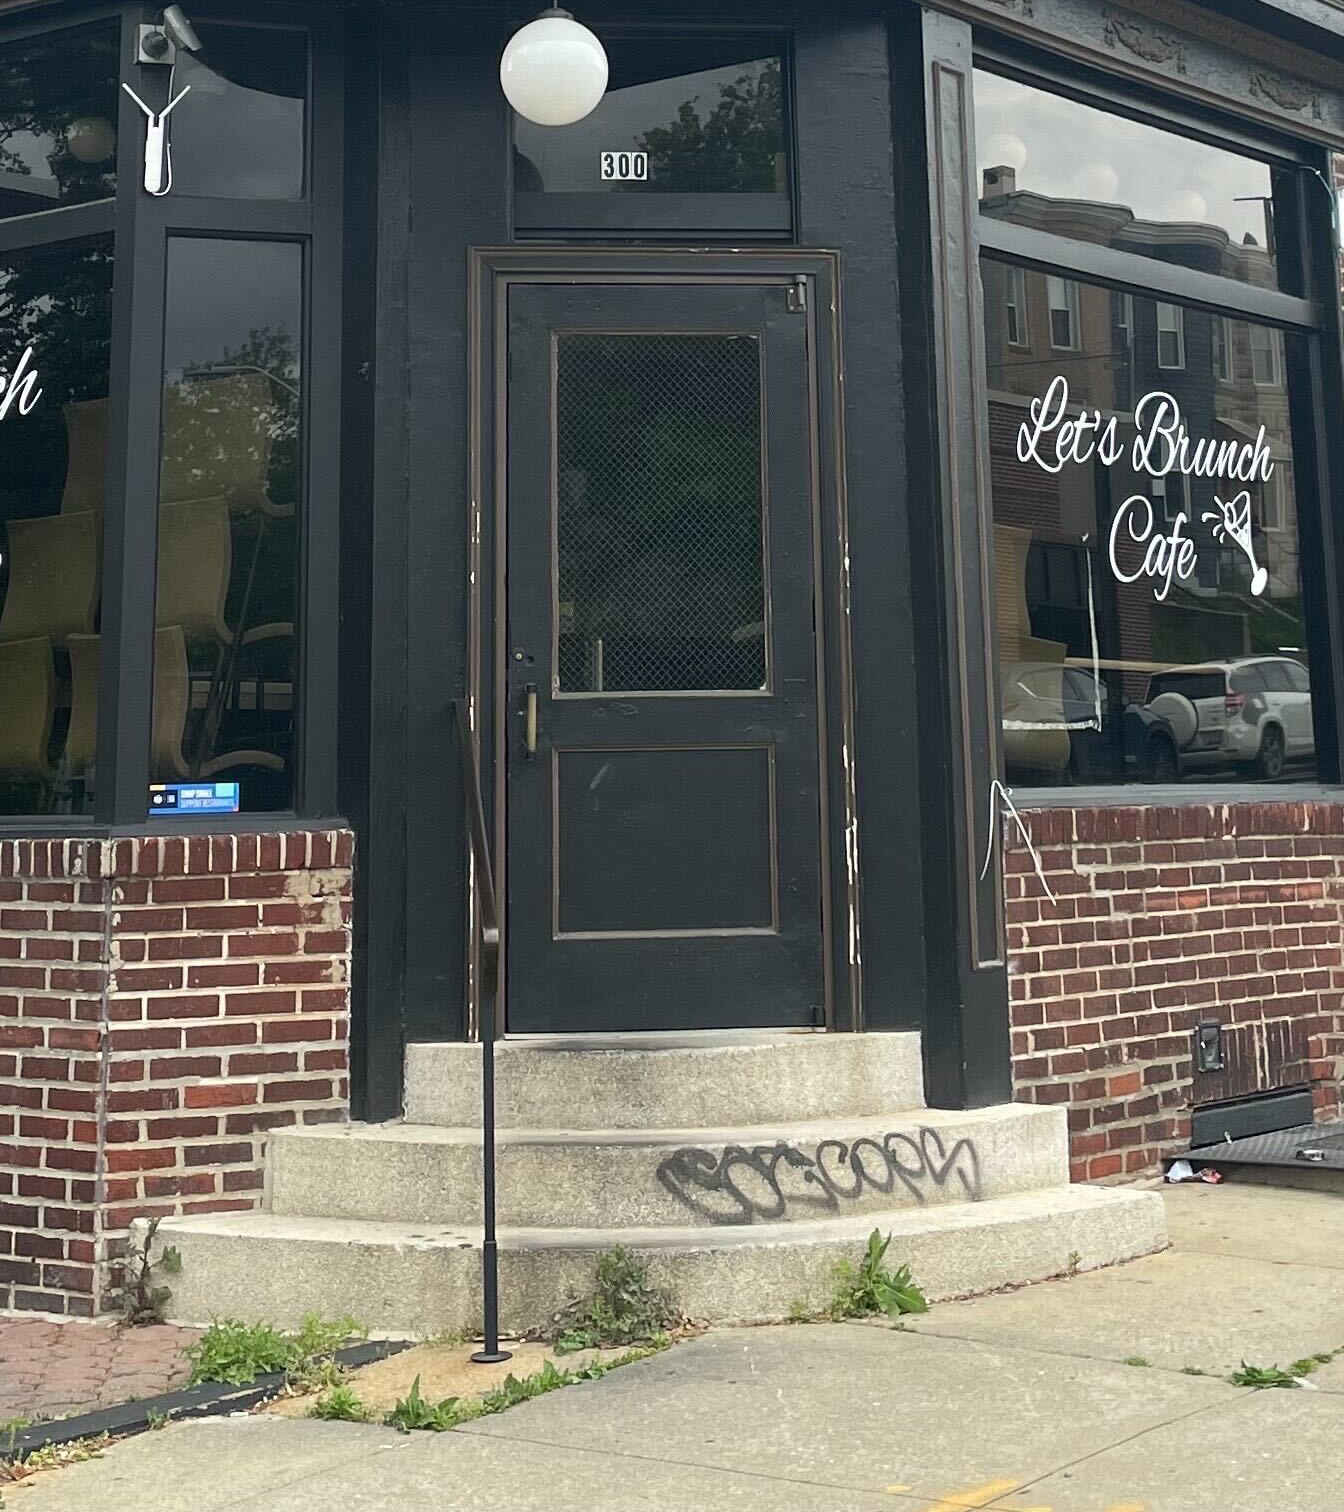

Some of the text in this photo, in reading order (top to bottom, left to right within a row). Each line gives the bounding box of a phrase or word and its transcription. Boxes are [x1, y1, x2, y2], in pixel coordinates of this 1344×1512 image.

[603, 153, 645, 178] 300
[1017, 375, 1274, 482] Let's Brunch
[1109, 495, 1198, 601] Cafe
